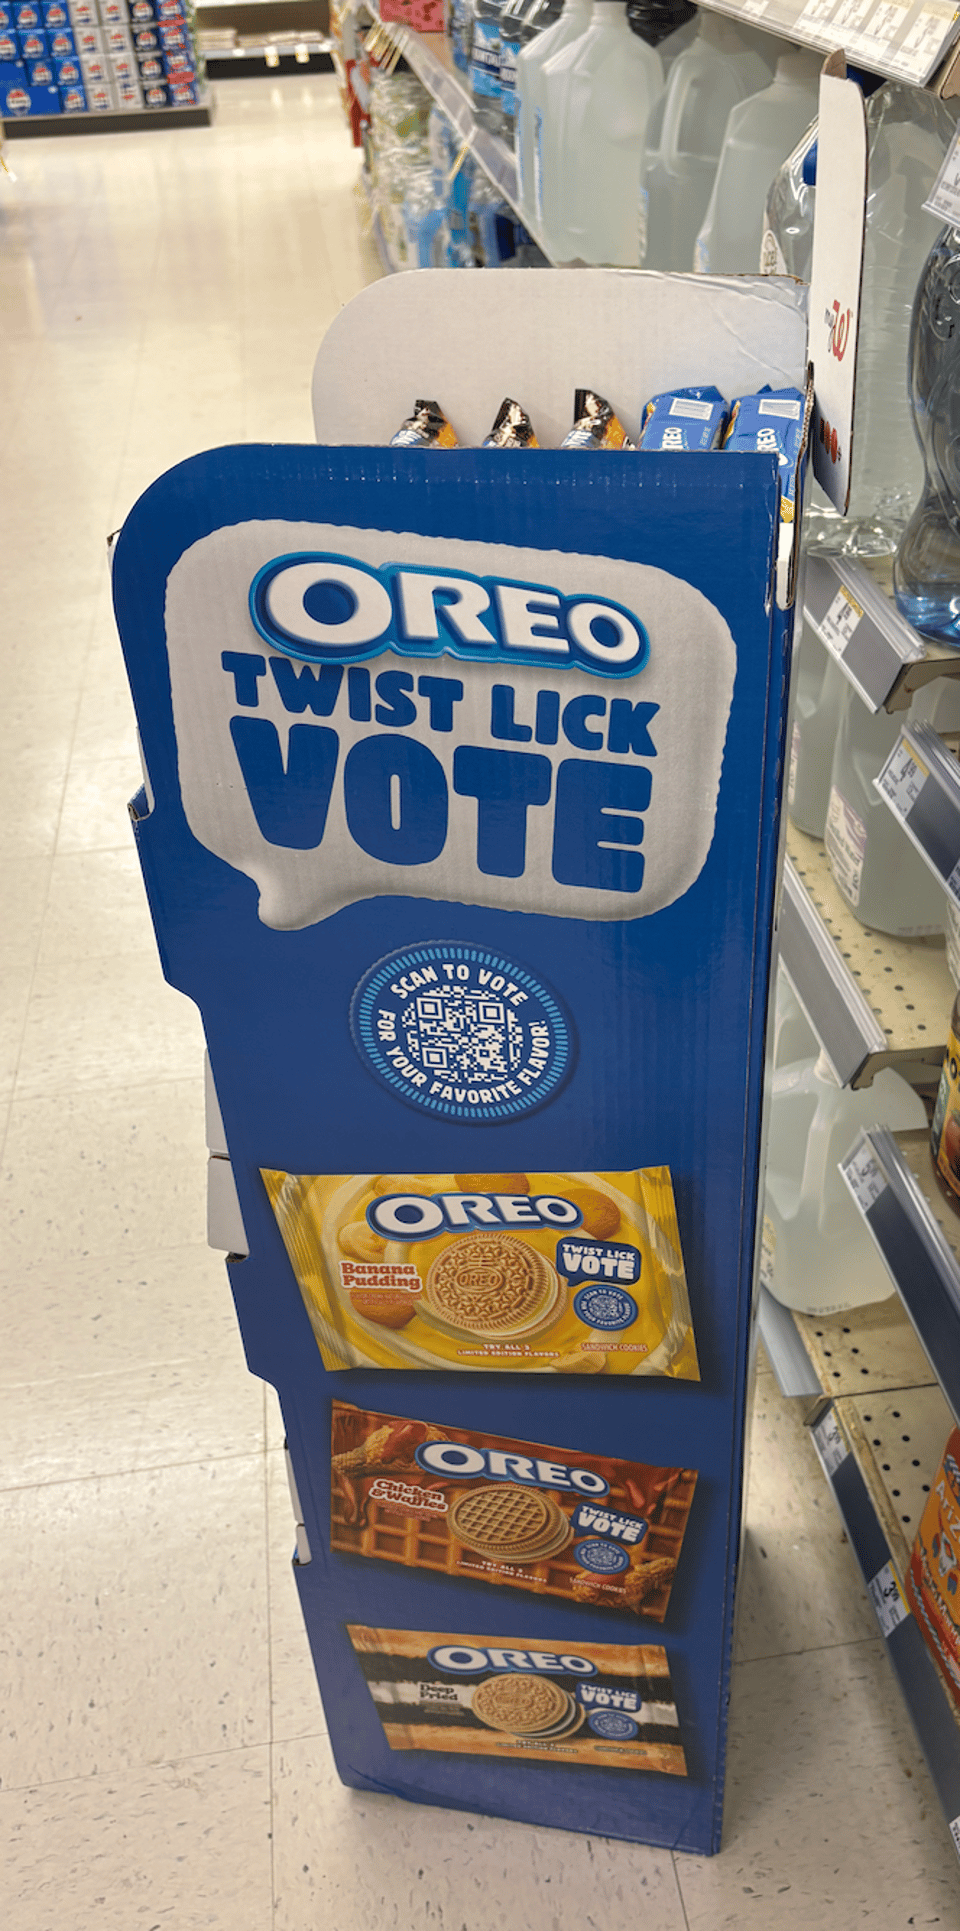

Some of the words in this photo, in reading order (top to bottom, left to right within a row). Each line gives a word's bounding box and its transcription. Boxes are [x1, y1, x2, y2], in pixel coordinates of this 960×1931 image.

[263, 560, 643, 666] OREO
[221, 650, 464, 732] TWIST
[491, 684, 661, 757] LICK
[230, 715, 653, 893] VOTE
[390, 965, 438, 999] SCAN
[442, 963, 470, 980] TO
[478, 968, 528, 1006] VOTE
[377, 1009, 396, 1042] FOR
[386, 1046, 428, 1087] YOUR
[516, 1020, 551, 1086] FLAVOR!
[429, 1080, 523, 1104] FAVORITE
[374, 1193, 578, 1234] OREO
[562, 1243, 604, 1257] TWIST
[607, 1249, 636, 1261] LICK
[562, 1252, 635, 1280] VOTE
[341, 1262, 416, 1275] Banana
[343, 1275, 421, 1290] Pudding
[422, 1442, 606, 1493] OREO
[578, 1511, 640, 1542] VOTE
[582, 1505, 617, 1521] TWIST
[618, 1517, 644, 1530] LICK
[433, 1646, 594, 1673] OREO
[420, 1683, 455, 1695] Deep
[581, 1690, 637, 1711] VOTE
